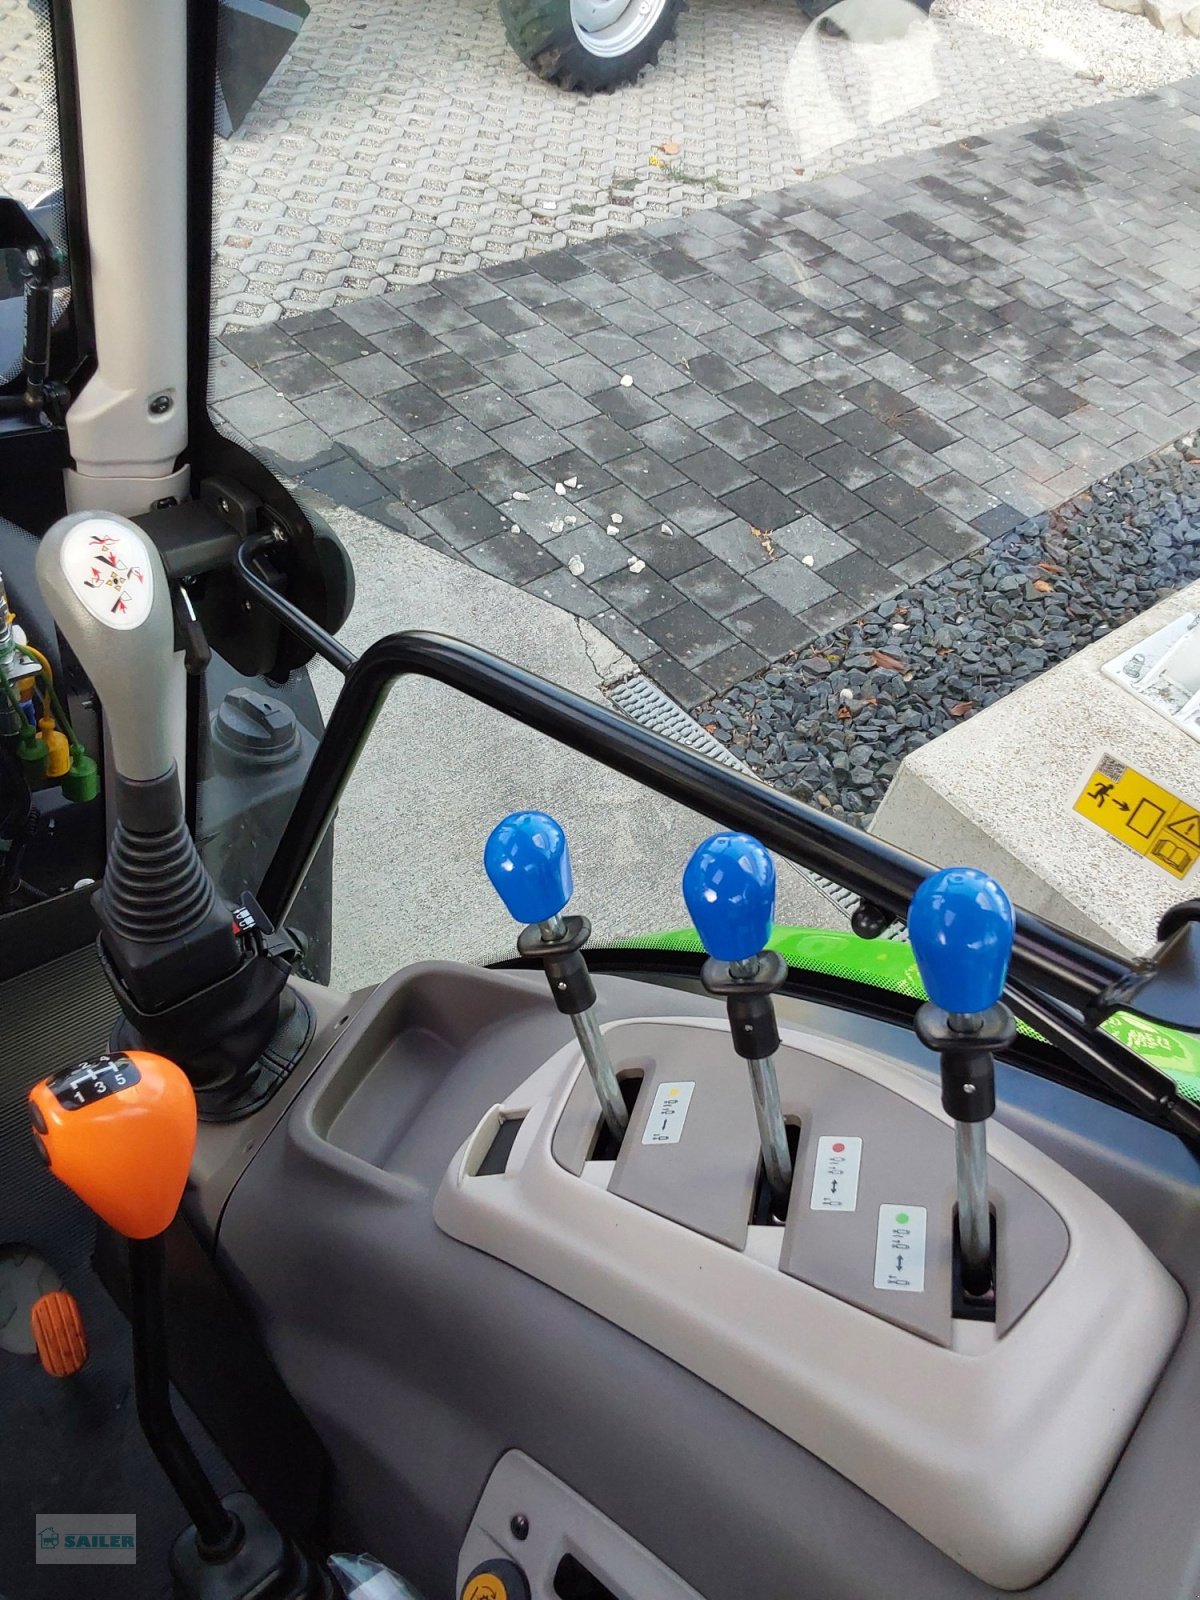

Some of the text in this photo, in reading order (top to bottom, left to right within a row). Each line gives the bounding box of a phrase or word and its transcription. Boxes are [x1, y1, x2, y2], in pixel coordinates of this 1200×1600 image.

[78, 1061, 91, 1070] 2
[74, 1073, 127, 1103] 1 3 5
